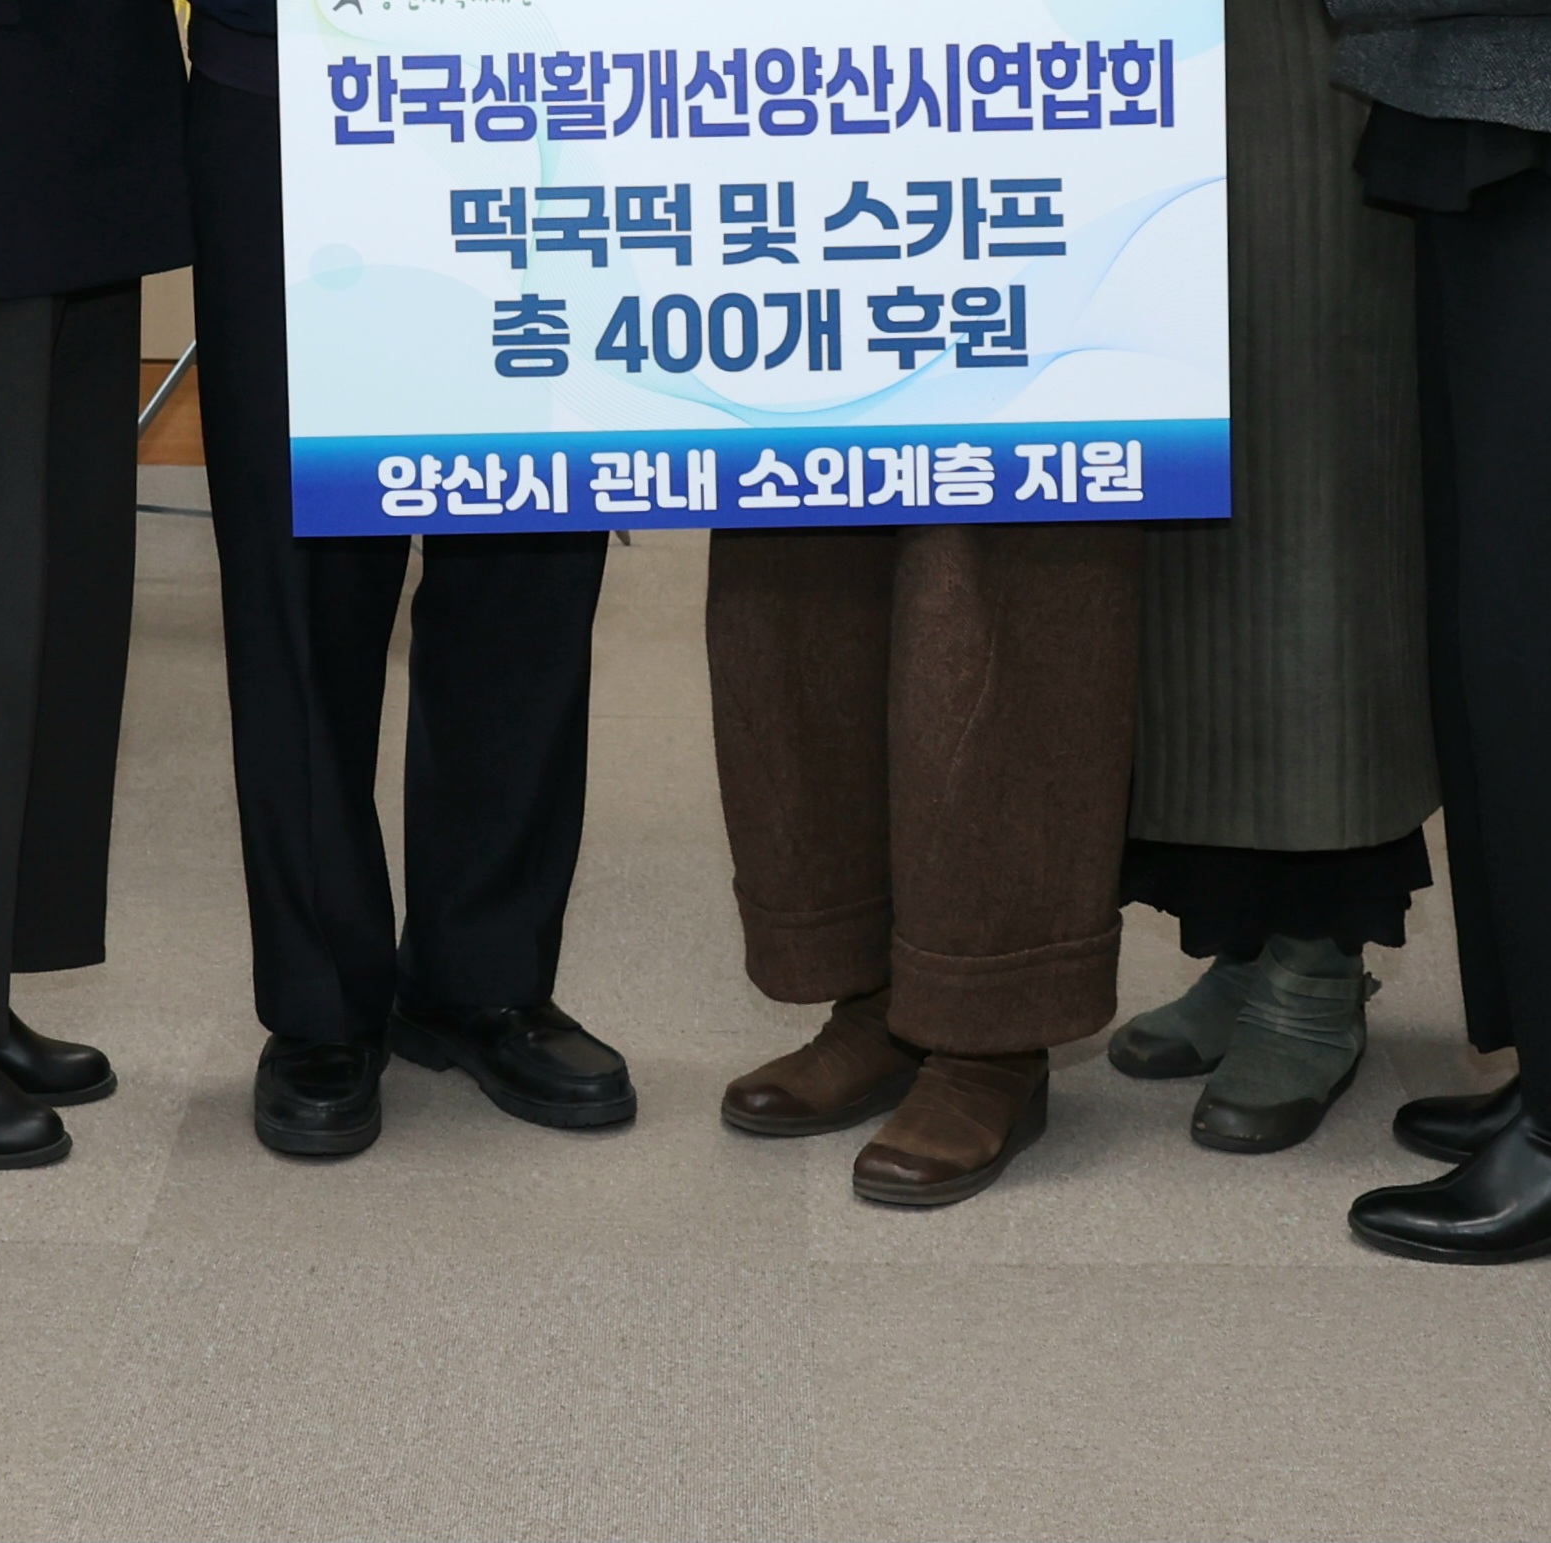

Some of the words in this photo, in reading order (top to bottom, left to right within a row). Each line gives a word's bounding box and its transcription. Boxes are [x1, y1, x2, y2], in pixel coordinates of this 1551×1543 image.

[327, 39, 1175, 146] 한국생활개선양산시연합회
[450, 183, 693, 270] 떡국떡
[718, 181, 800, 265] 및
[822, 177, 1067, 261] 스카프
[490, 295, 570, 378] 총
[594, 289, 842, 374] 400개
[866, 285, 1028, 369] 후원
[377, 452, 568, 518] 양산시
[589, 449, 718, 513] 관내
[737, 443, 996, 509] 소외계층
[1014, 441, 1144, 504] 지원
